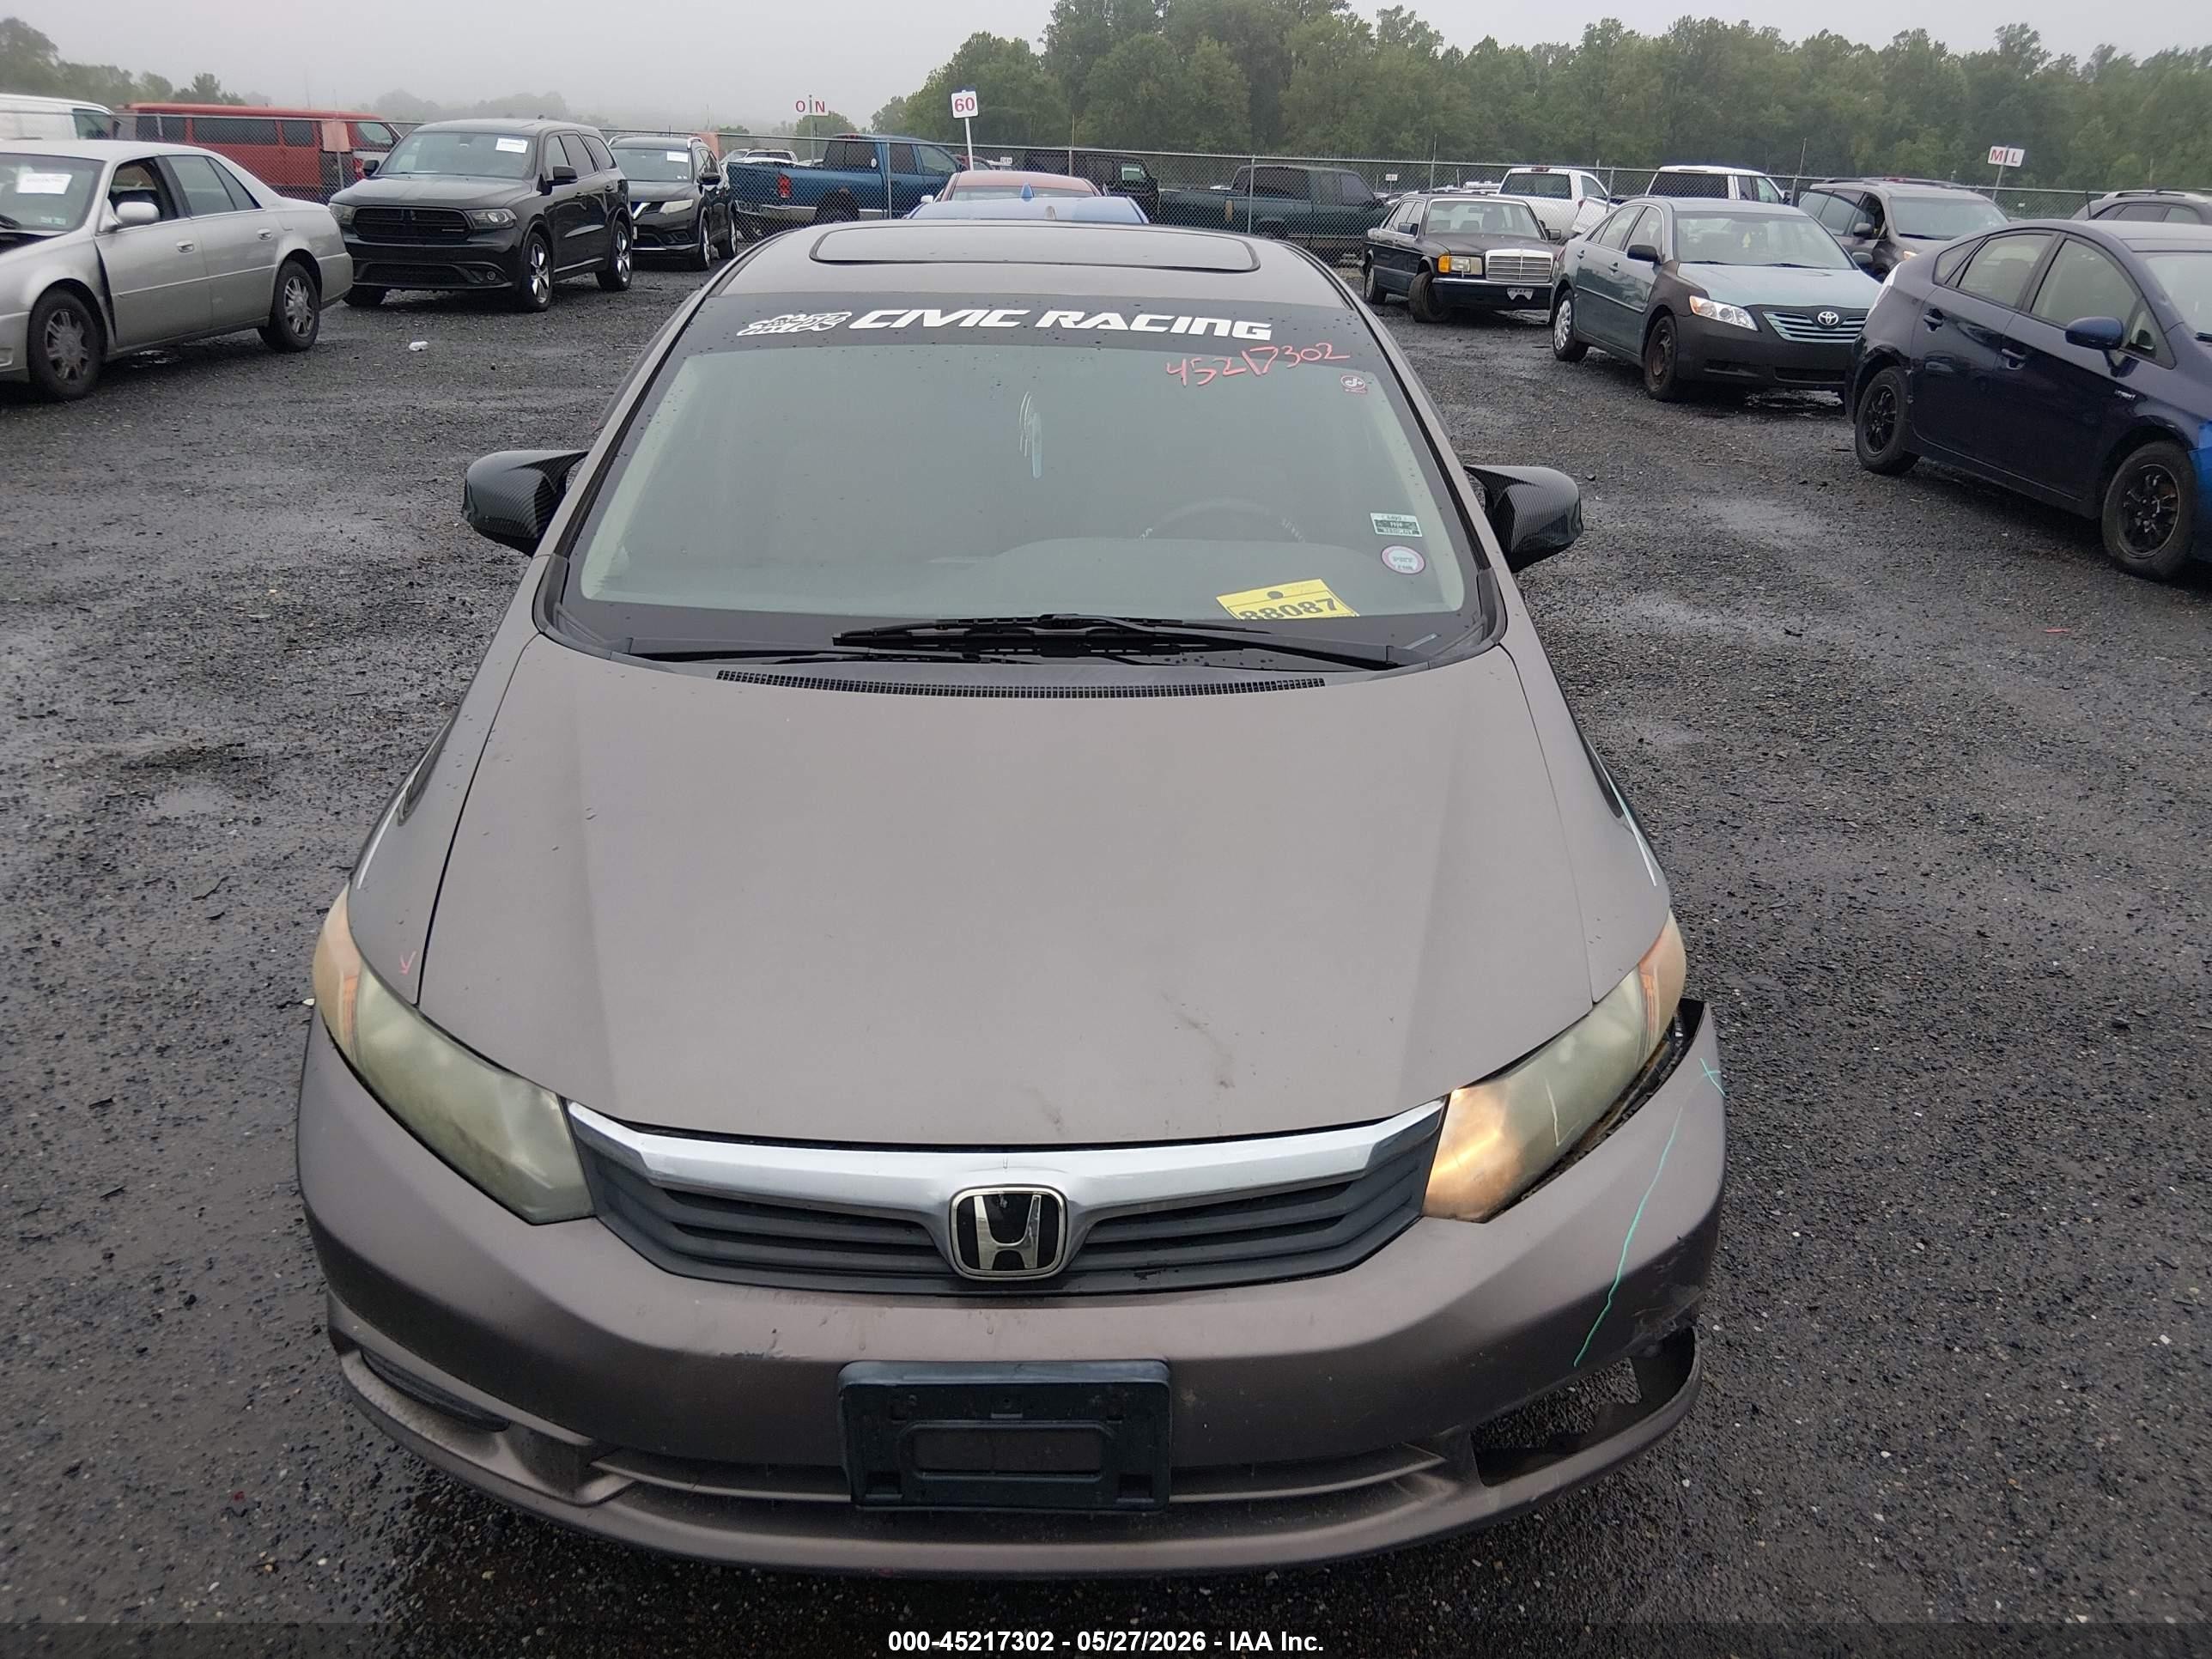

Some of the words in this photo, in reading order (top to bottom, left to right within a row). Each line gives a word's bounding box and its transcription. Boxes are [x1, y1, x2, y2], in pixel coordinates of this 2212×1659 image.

[954, 96, 975, 112] 60
[848, 309, 1030, 329] CIVIC
[1034, 310, 1272, 341] RACING
